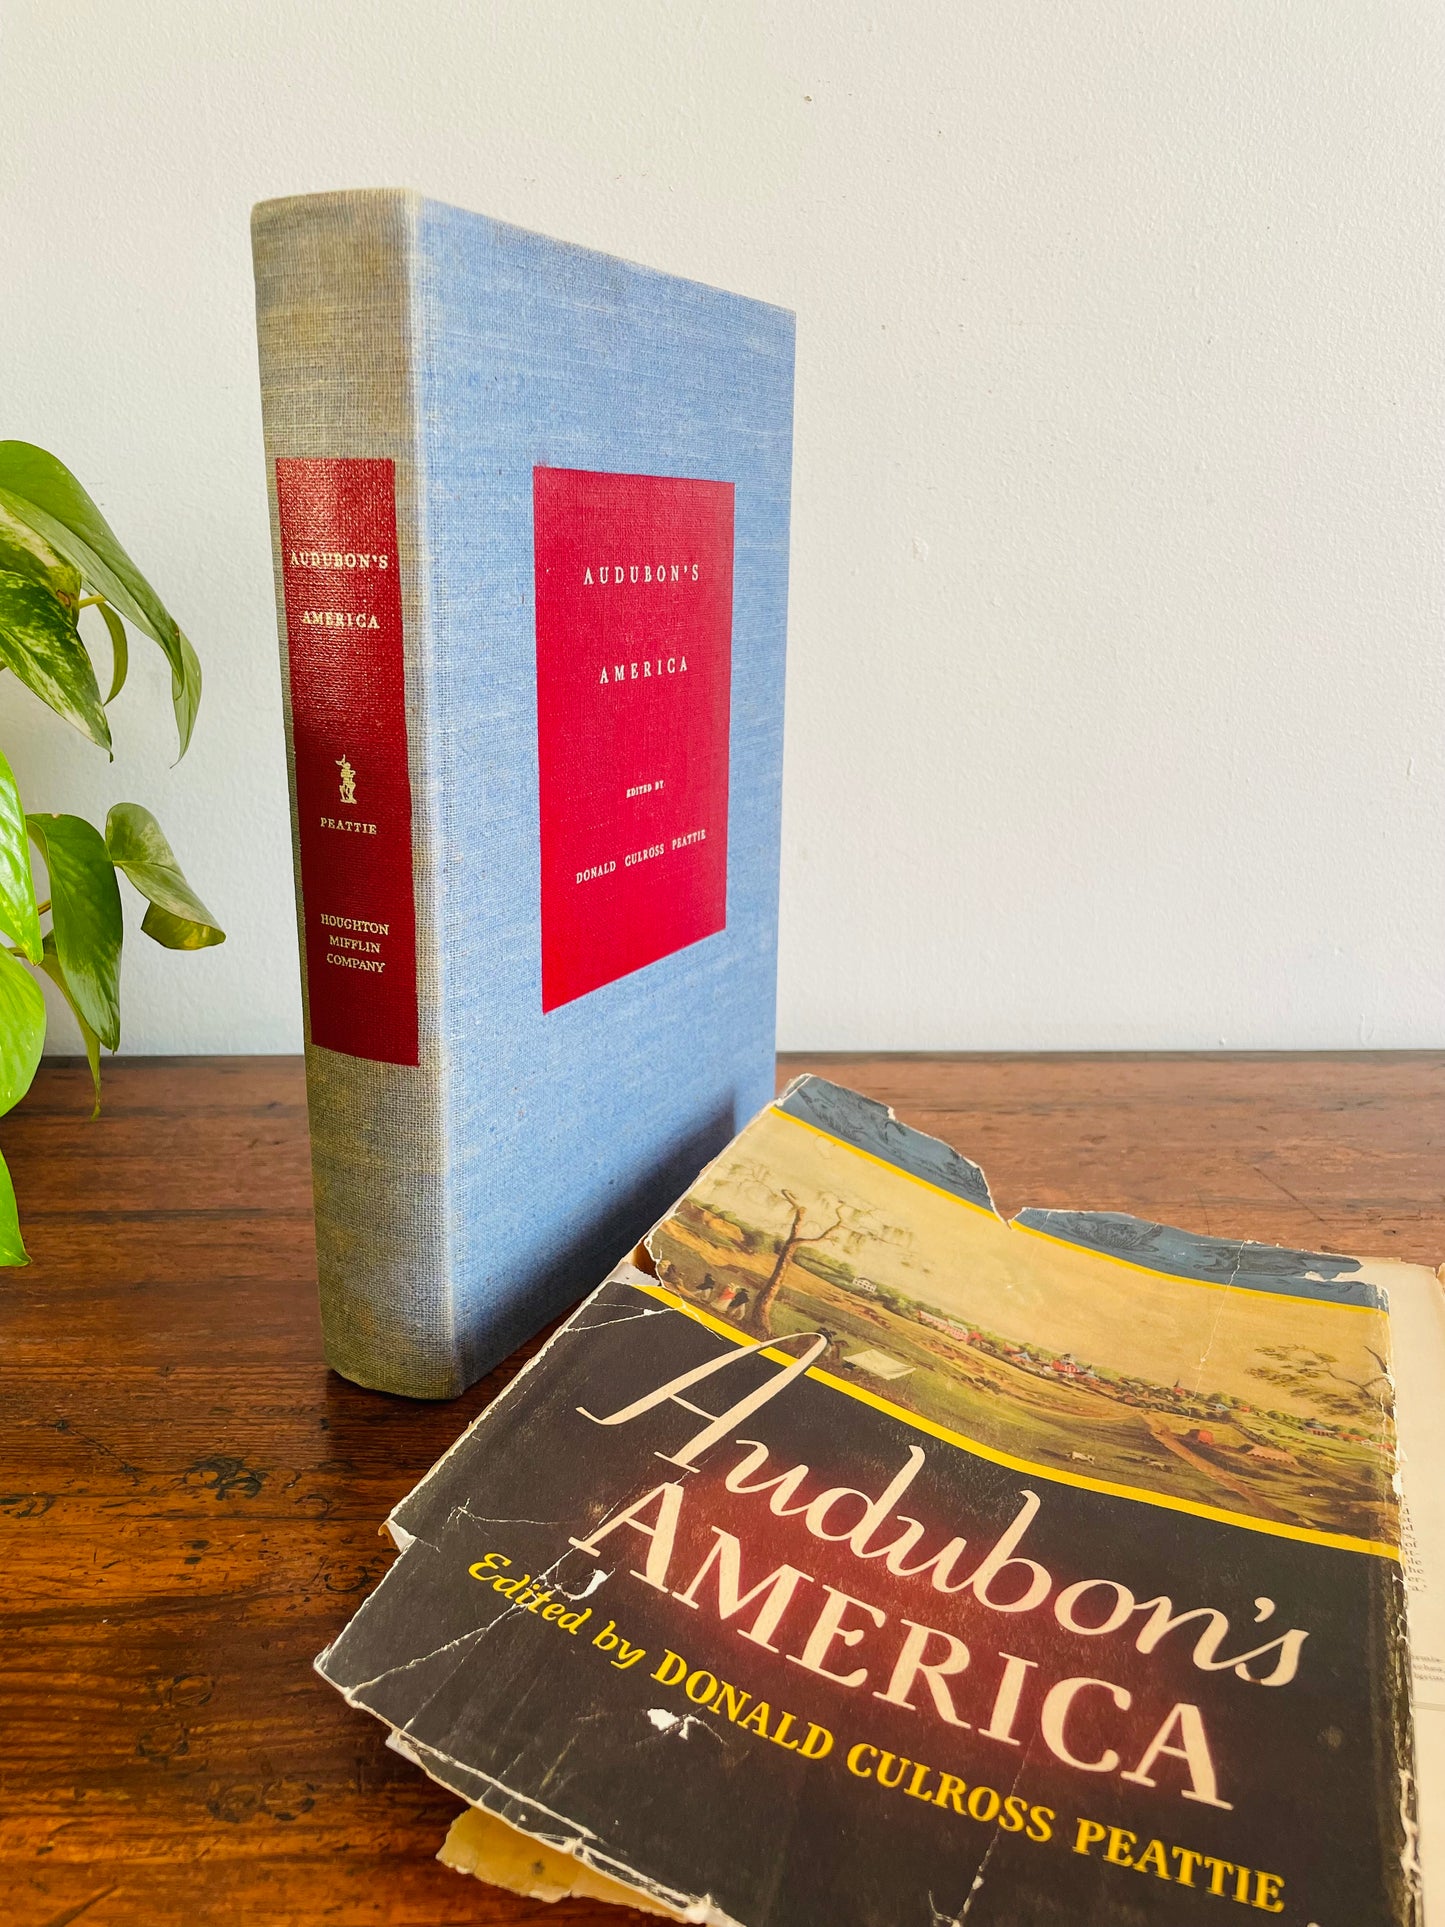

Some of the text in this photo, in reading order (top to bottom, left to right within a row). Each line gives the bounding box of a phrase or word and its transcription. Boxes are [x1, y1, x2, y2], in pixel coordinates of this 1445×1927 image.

[290, 550, 389, 569] AUDUBON'S
[583, 563, 699, 585] AUDUBON'S
[302, 610, 381, 629] AMERICA
[599, 655, 688, 684] AMERICA
[625, 780, 664, 798] EDITED BY
[320, 816, 377, 835] PEATTIE
[576, 828, 706, 884] DONALD CULROSS PEATTIE
[320, 913, 390, 935] HOUGHTON
[329, 935, 381, 954] MIFFLIN
[326, 953, 386, 973] COMPANY
[575, 1332, 1309, 1687] Audubon's
[568, 1481, 1234, 1810] AMERICA
[467, 1551, 1286, 1913] Edited by DONALD CULROSS PEATTIE
